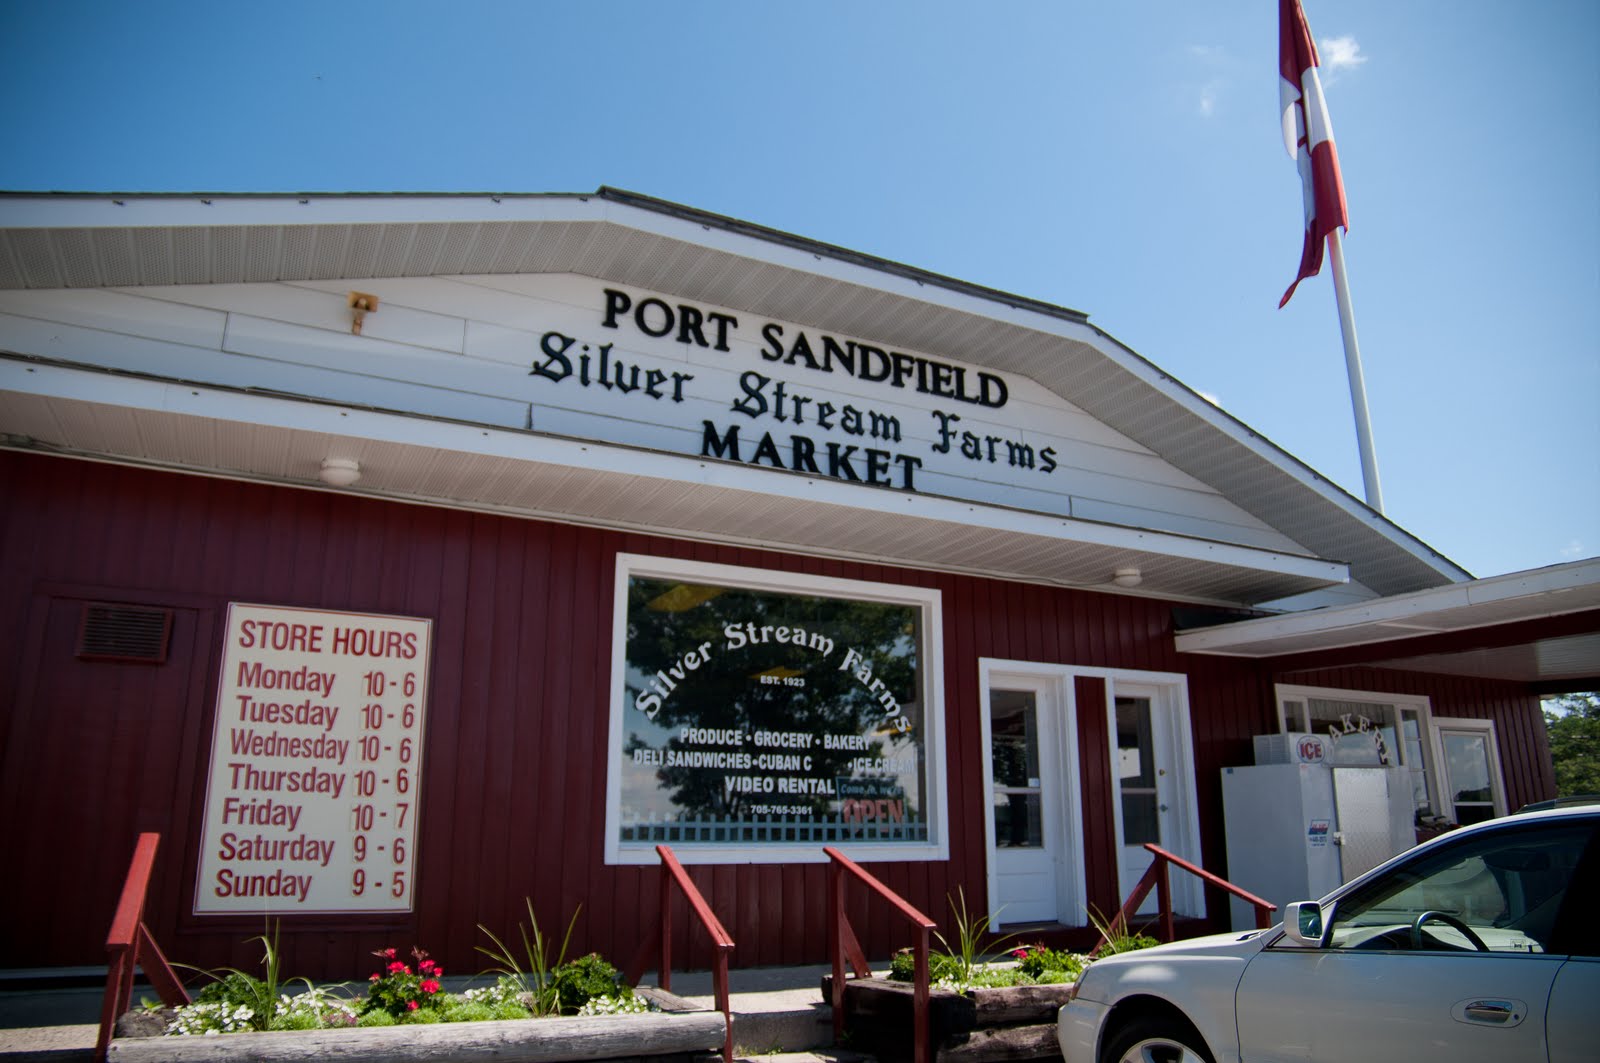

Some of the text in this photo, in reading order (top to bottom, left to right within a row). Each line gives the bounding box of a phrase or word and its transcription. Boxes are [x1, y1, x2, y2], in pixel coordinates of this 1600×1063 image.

[602, 288, 1009, 409] PORT SANDFIELD
[529, 331, 1058, 474] Silver Stream Farms
[700, 420, 922, 491] MARKET
[238, 620, 417, 659] STORE HOURS
[236, 661, 336, 698] Monday
[635, 622, 912, 733] Silver Stream Farms
[760, 675, 805, 687] EST. 1923
[236, 695, 339, 731] Tuesday
[230, 728, 350, 765] Wednesday
[680, 728, 871, 750] PRODUCE GROCERY BAKERY
[1300, 742, 1322, 760] ICE
[1328, 712, 1394, 764] AKERY
[634, 748, 663, 766] DELI
[875, 758, 915, 774] CREAM
[228, 763, 346, 799] Thursday
[725, 776, 836, 795] VIDEO RENTAL
[221, 798, 302, 832] Friday
[751, 804, 813, 815] 705-765-3361
[843, 798, 903, 832] OPEN
[218, 832, 335, 867] Saturday
[215, 868, 312, 902] Sunday
